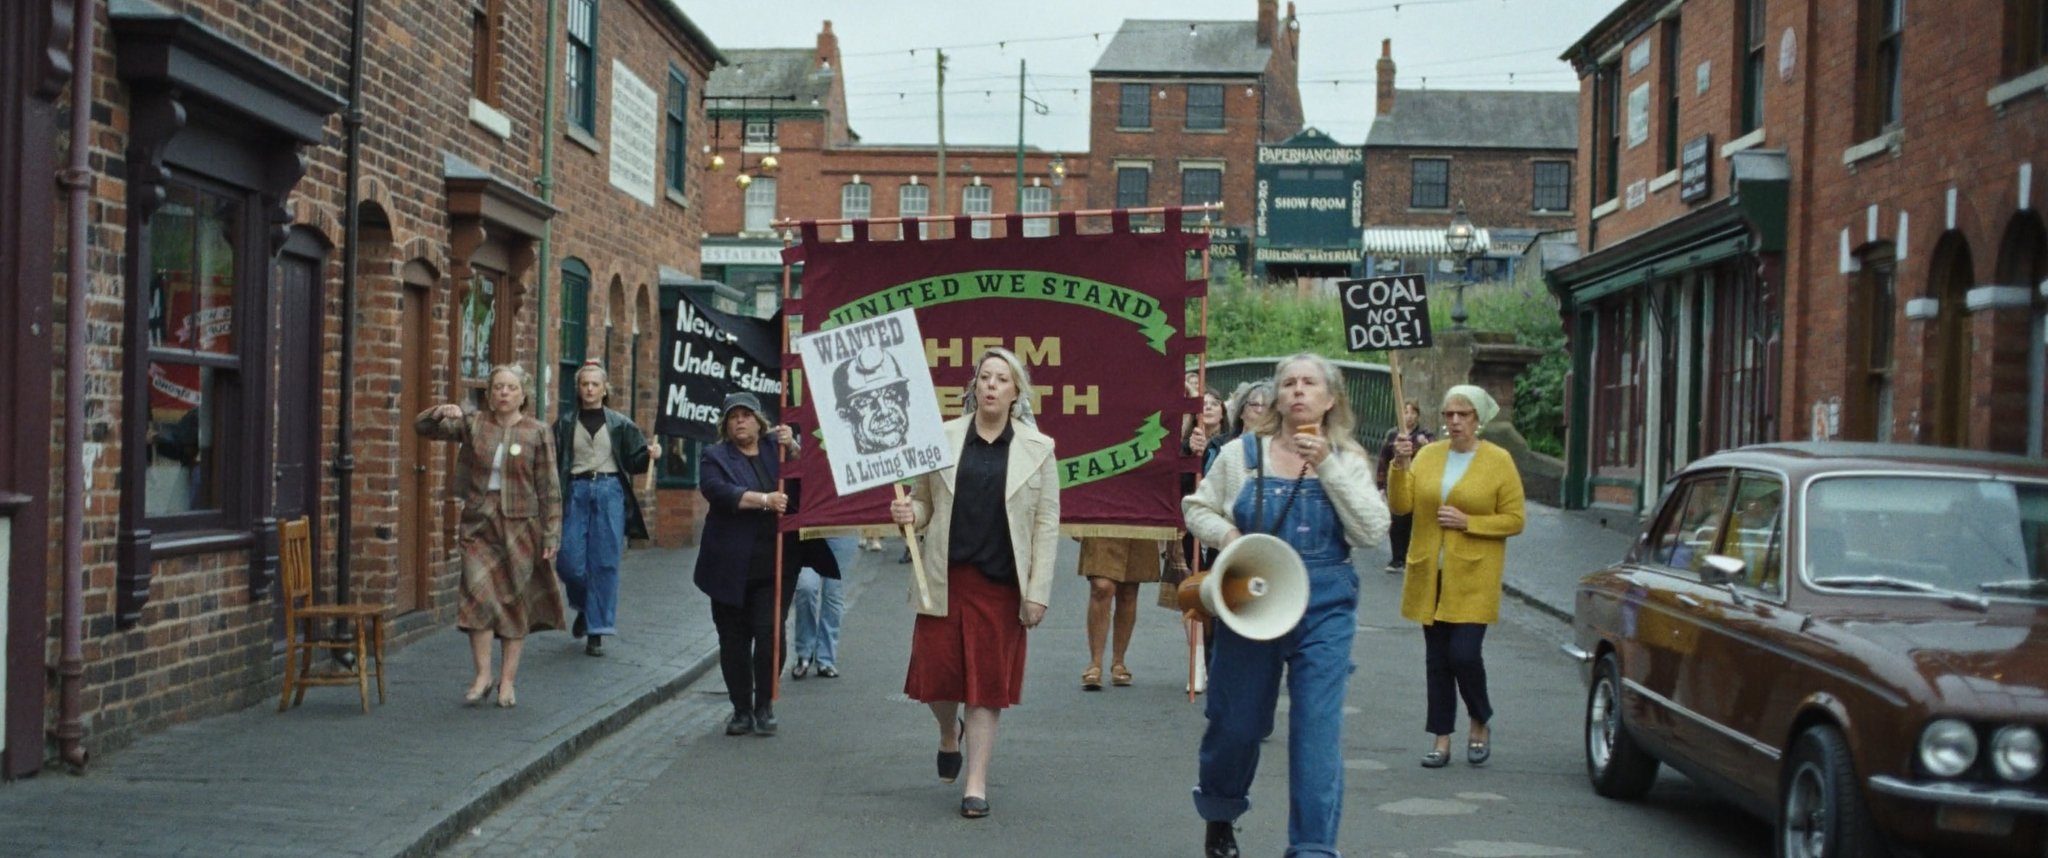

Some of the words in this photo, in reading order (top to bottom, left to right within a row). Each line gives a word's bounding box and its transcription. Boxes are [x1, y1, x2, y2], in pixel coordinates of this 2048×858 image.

[1259, 147, 1362, 164] PAPERHANGINGS
[1258, 180, 1269, 236] GRATES
[1274, 197, 1309, 209] SHOW
[1310, 197, 1346, 211] ROOM
[705, 249, 778, 260] ESTAURAN
[1210, 244, 1236, 256] ROS
[1257, 248, 1306, 261] BUILDING
[834, 278, 960, 325] UNITED
[976, 274, 1026, 294] WE
[1041, 276, 1153, 320] STAND
[1346, 278, 1427, 309] COAL
[1367, 305, 1416, 325] NOT
[813, 316, 905, 365] WANTED
[1350, 319, 1423, 350] DOLE!
[730, 357, 786, 394] Estima
[666, 384, 721, 424] Miners
[845, 463, 857, 487] A
[857, 453, 904, 478] Living
[904, 444, 942, 469] Wage
[1065, 442, 1148, 482] FALL
